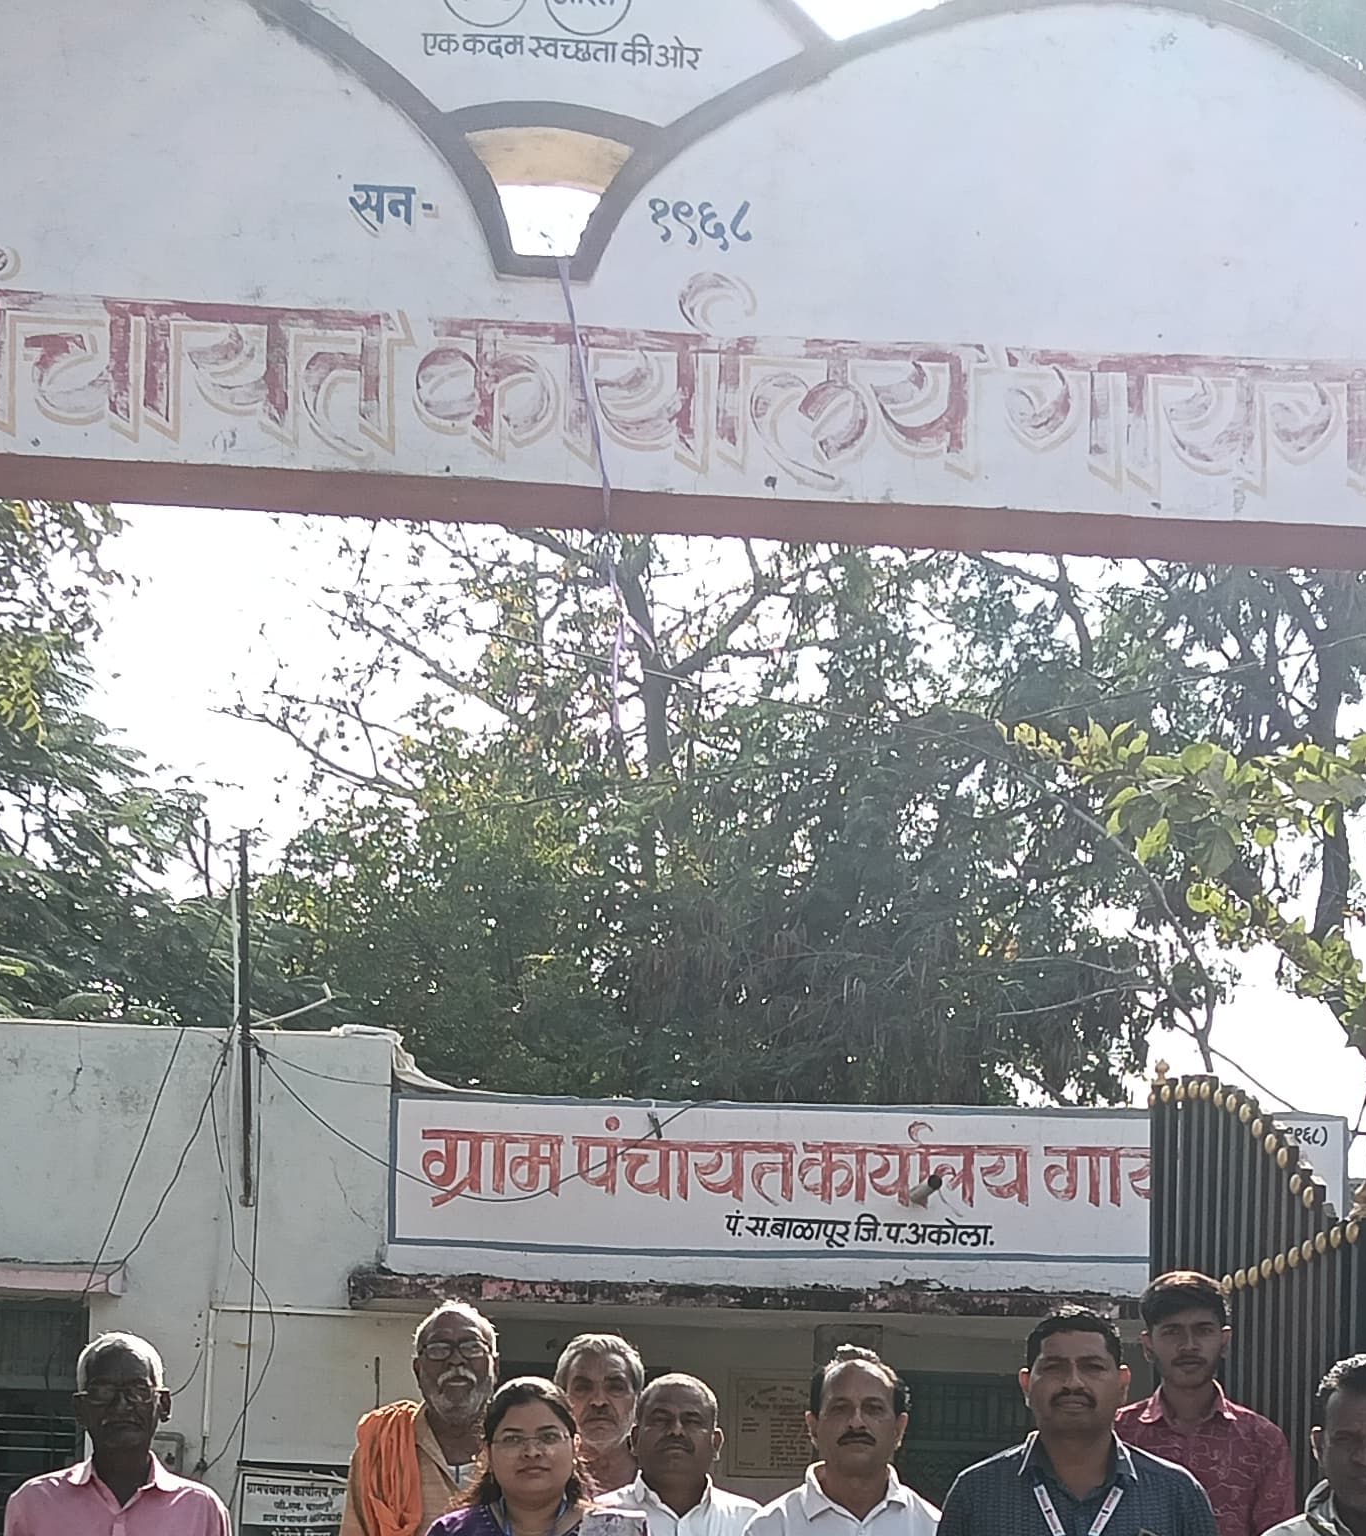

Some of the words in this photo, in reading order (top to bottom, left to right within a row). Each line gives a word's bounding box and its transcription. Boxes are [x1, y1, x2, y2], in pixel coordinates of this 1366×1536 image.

[421, 32, 460, 56] एक
[462, 33, 525, 59] कदम
[528, 36, 618, 63] स्वच्छता
[621, 33, 654, 67] की
[654, 36, 703, 70] ओर
[648, 197, 753, 252] १९६८
[414, 272, 990, 488] कार्यालय
[422, 1129, 564, 1207] ग्राम
[572, 1116, 796, 1206] पंचायत
[798, 1121, 1031, 1208] कार्यालय
[1285, 1126, 1328, 1147] ९६८)
